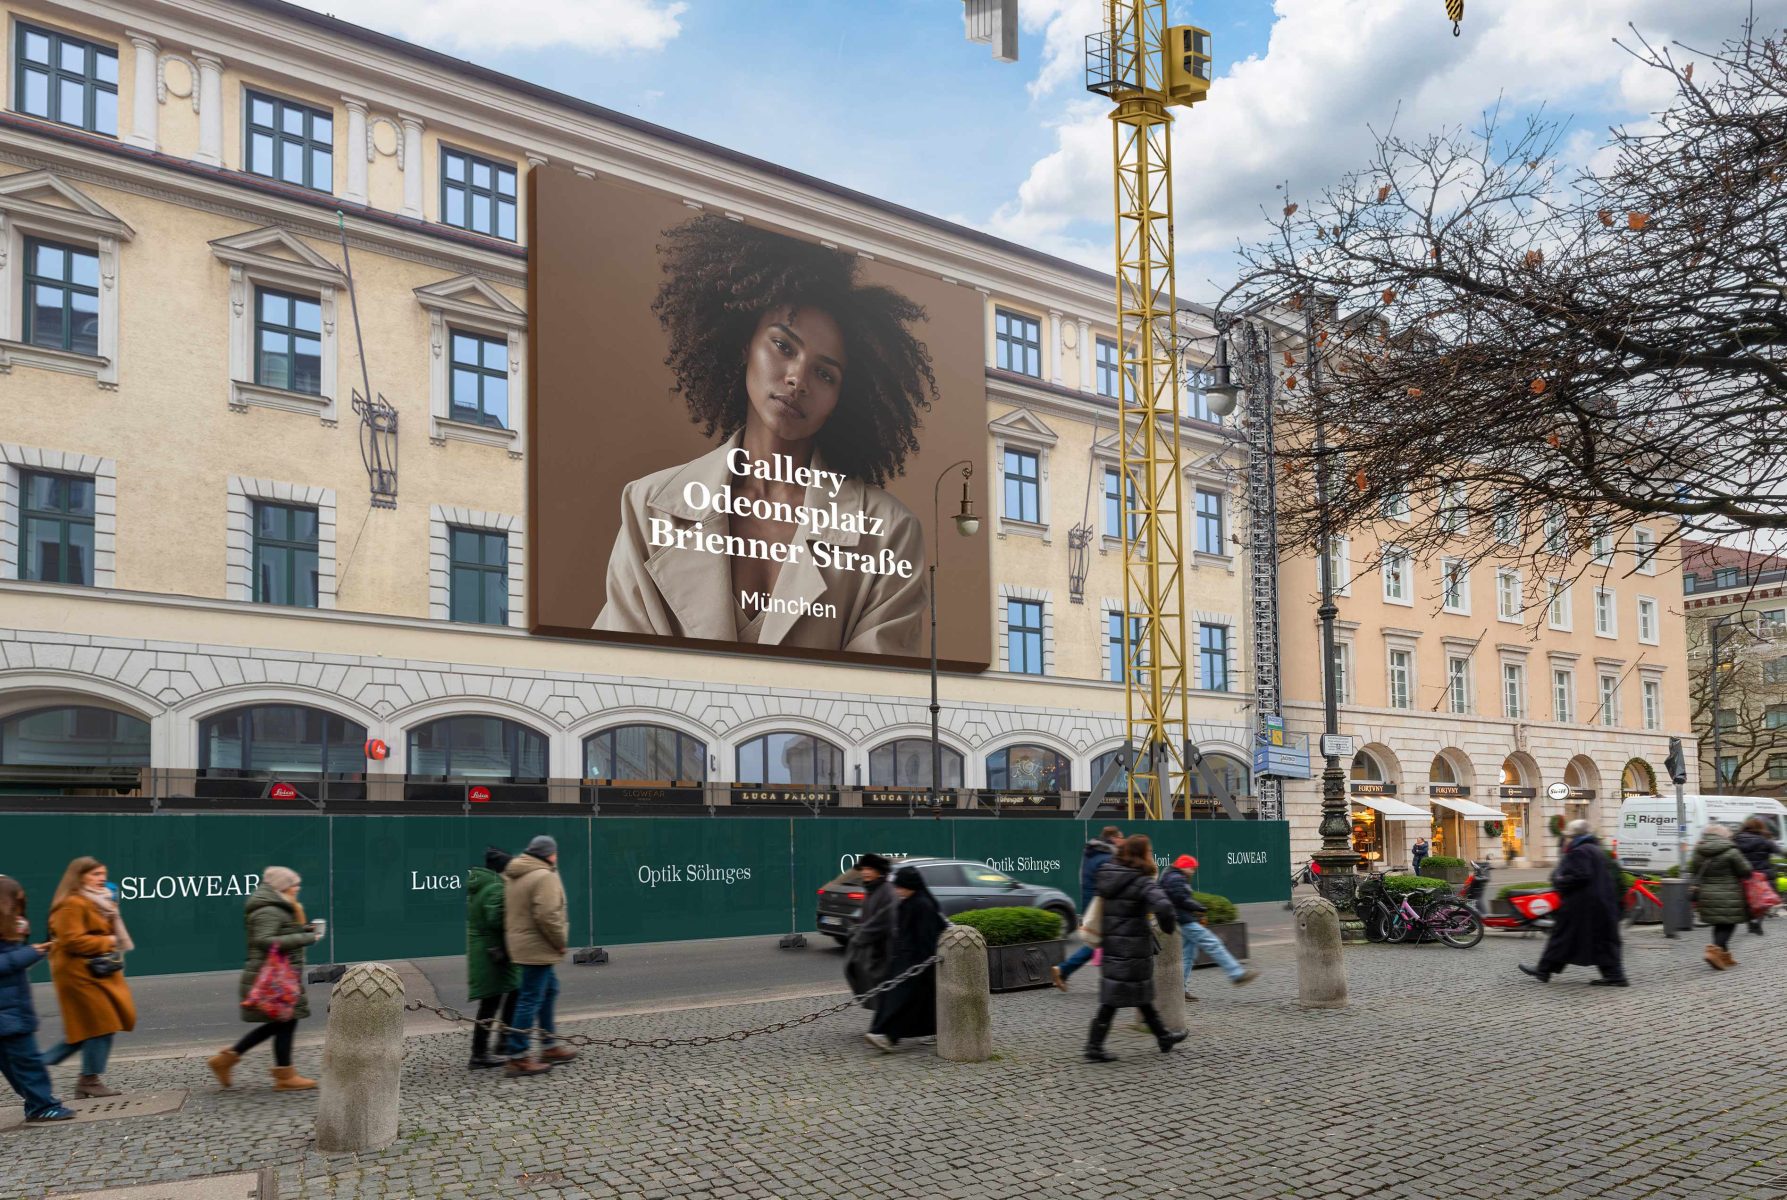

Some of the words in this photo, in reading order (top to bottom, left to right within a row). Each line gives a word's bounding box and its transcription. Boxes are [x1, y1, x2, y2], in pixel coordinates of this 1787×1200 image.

[726, 447, 846, 497] Gallery
[683, 481, 884, 537] Odeonsplatz
[648, 517, 804, 565] Brienner
[812, 540, 913, 579] Straße
[741, 590, 837, 619] München
[742, 792, 776, 800] LUCA
[784, 793, 831, 801] FALONI
[1639, 815, 1678, 826] Rizgar
[985, 857, 1015, 872] Optik
[1017, 856, 1061, 873] Söhnges
[1227, 851, 1268, 865] SLOWEAR
[121, 874, 260, 900] SLOWEAR
[411, 871, 462, 889] Luca
[638, 865, 682, 888] Optik
[686, 864, 751, 885] Söhnges
